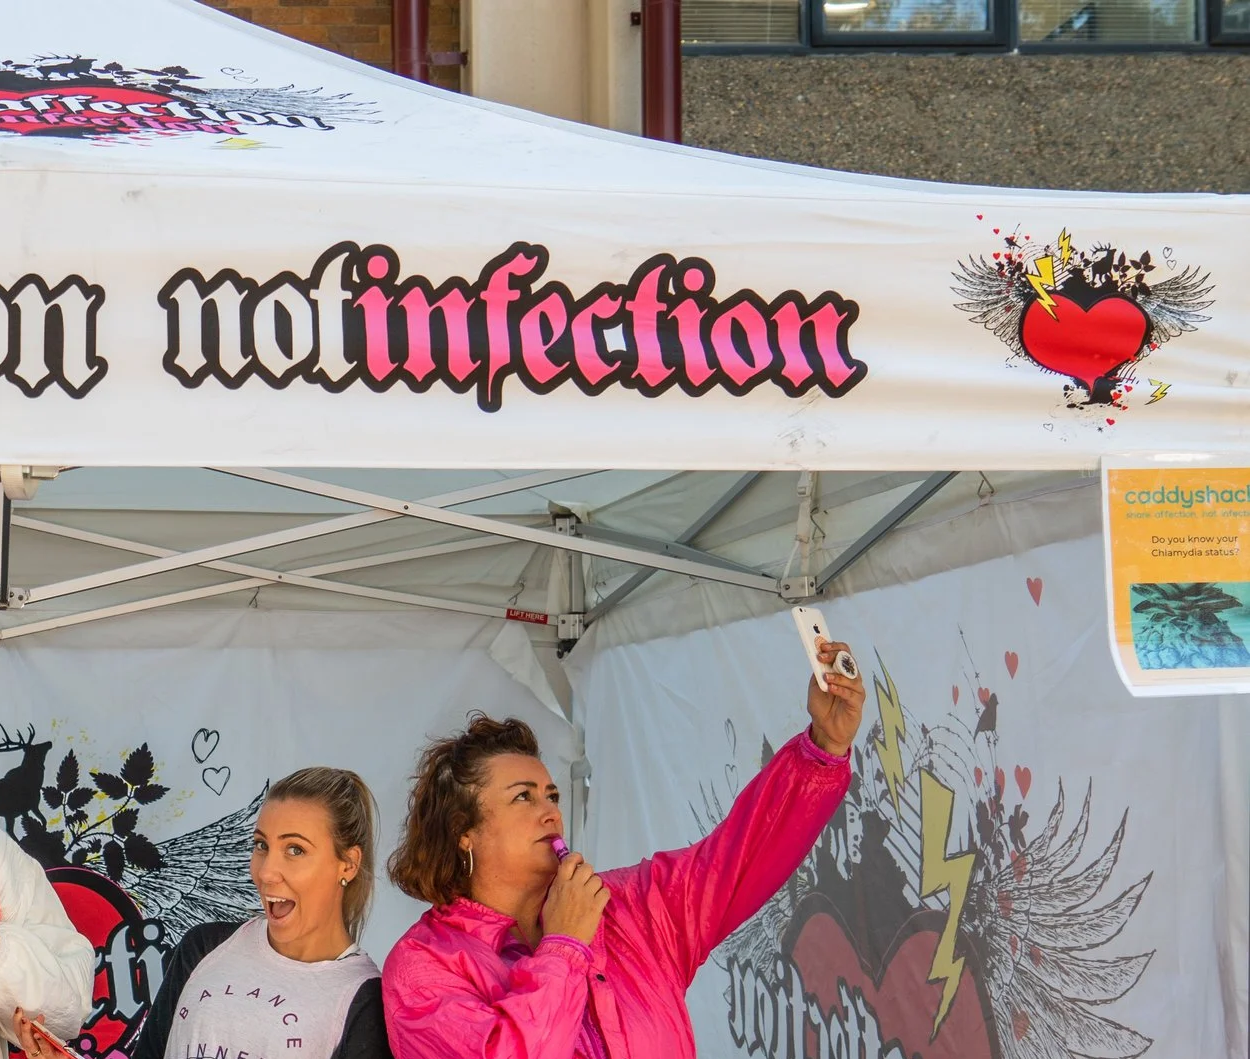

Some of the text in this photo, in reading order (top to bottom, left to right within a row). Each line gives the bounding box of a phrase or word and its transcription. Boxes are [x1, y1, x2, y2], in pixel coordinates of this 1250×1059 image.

[1202, 510, 1217, 518] not
[1151, 535, 1238, 545] Do you know your
[1151, 548, 1239, 558] Chlamydia status?
[179, 984, 302, 1049] BALANCE
